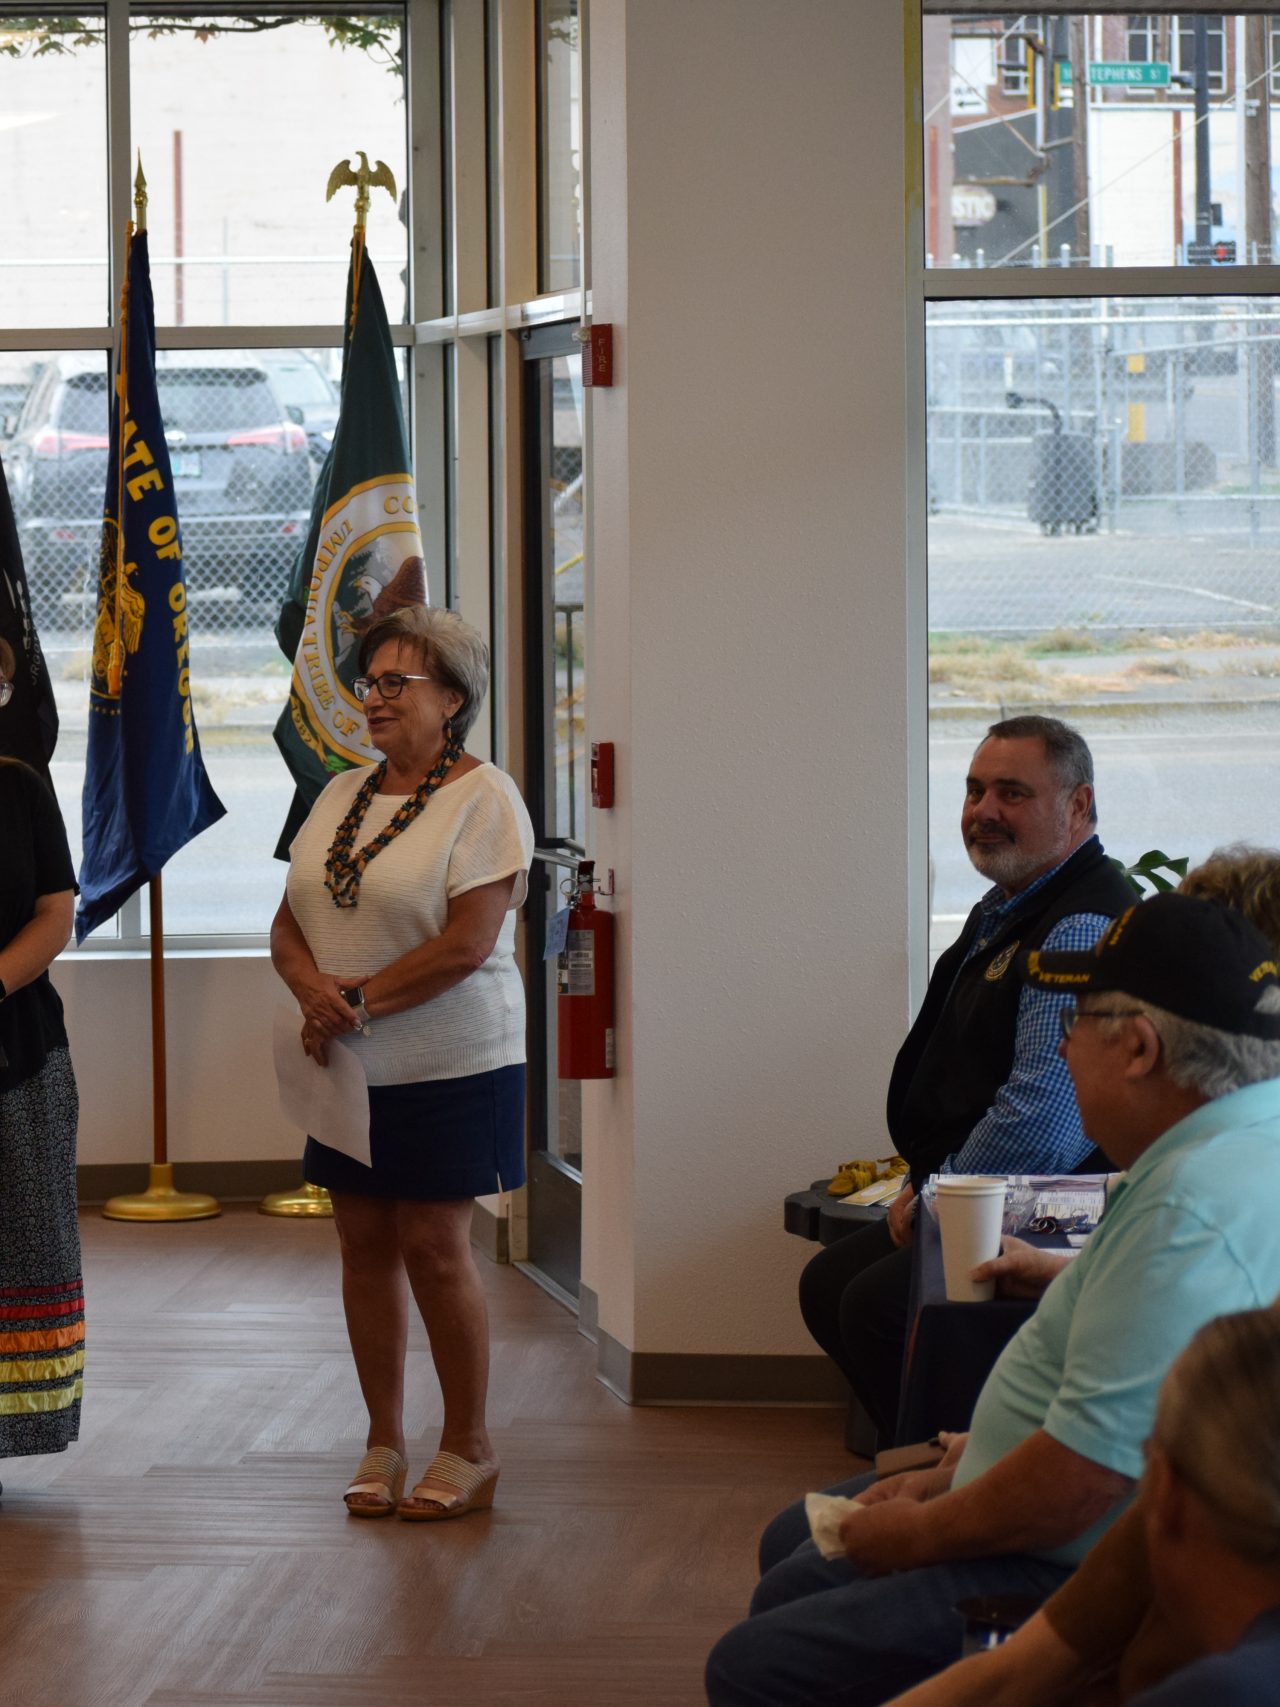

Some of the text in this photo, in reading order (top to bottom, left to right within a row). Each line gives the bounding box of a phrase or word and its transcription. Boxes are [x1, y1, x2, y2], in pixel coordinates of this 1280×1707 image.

[1090, 67, 1143, 81] TEPHENS
[598, 338, 608, 373] FIRE
[149, 515, 183, 560] OF
[331, 710, 360, 738] OF
[1039, 972, 1090, 983] VETERAN
